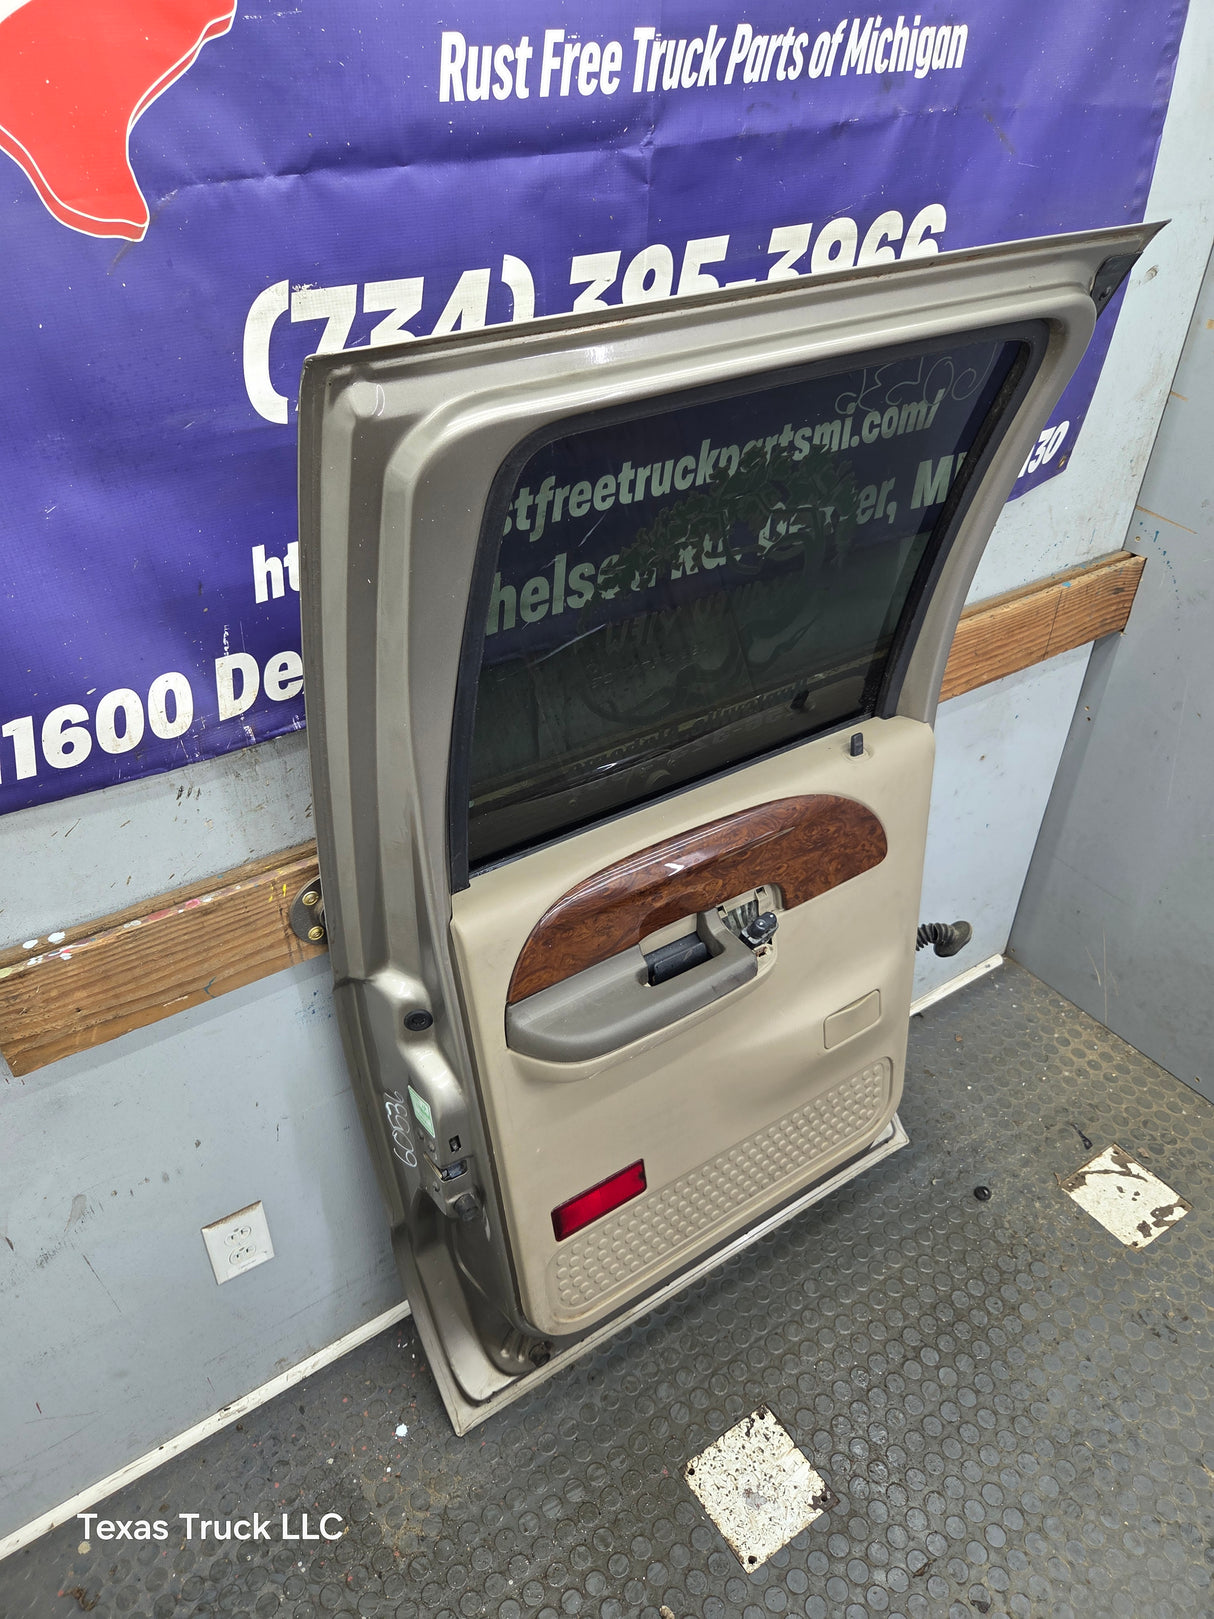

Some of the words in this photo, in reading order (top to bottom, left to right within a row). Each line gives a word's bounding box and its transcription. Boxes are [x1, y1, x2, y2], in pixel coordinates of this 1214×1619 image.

[439, 31, 532, 102] Rust
[540, 28, 622, 98] Free
[632, 25, 726, 93] Truck
[724, 23, 803, 86] Parts
[808, 19, 845, 79] of
[840, 14, 969, 79] Michigan
[569, 203, 947, 313] 3953966
